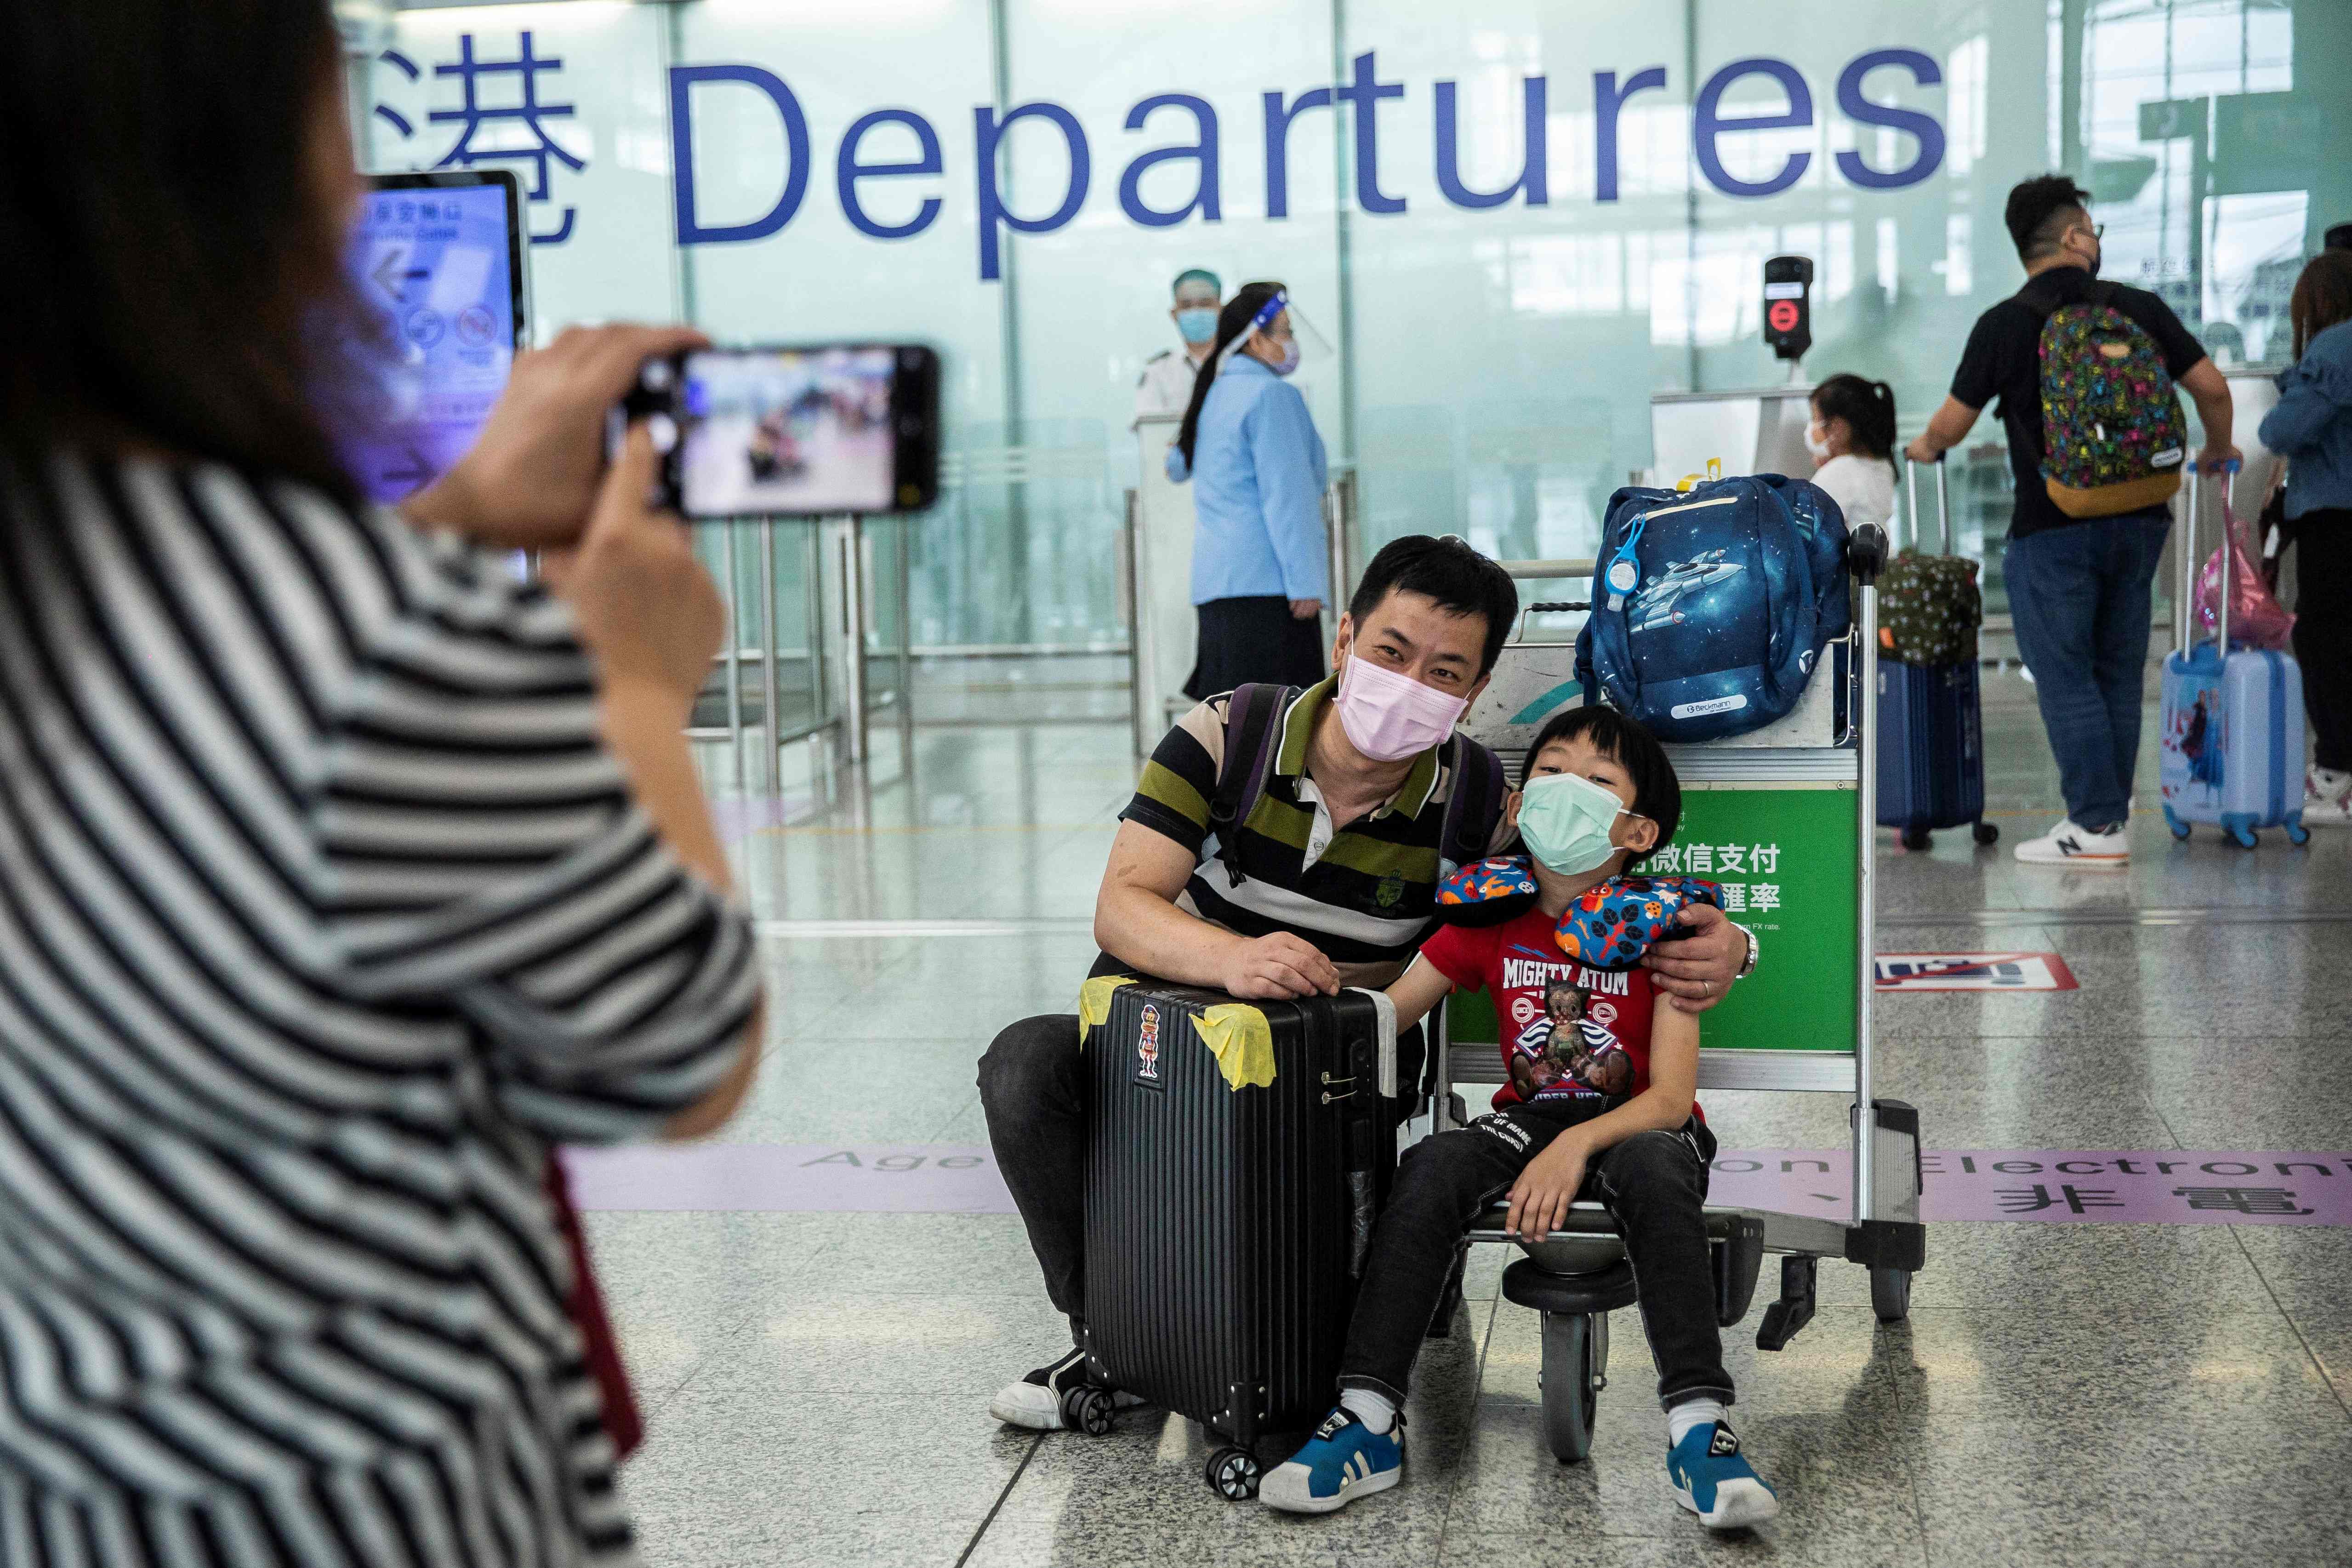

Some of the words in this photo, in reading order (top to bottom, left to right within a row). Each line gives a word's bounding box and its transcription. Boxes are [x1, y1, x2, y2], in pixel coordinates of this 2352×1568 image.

[375, 32, 585, 244] 港
[668, 48, 1946, 279] Departures
[1696, 701, 1731, 712] Beckmann
[1720, 882, 1780, 912] 匯率
[1503, 958, 1572, 989] MIGHTY
[1710, 1159, 1830, 1172] on
